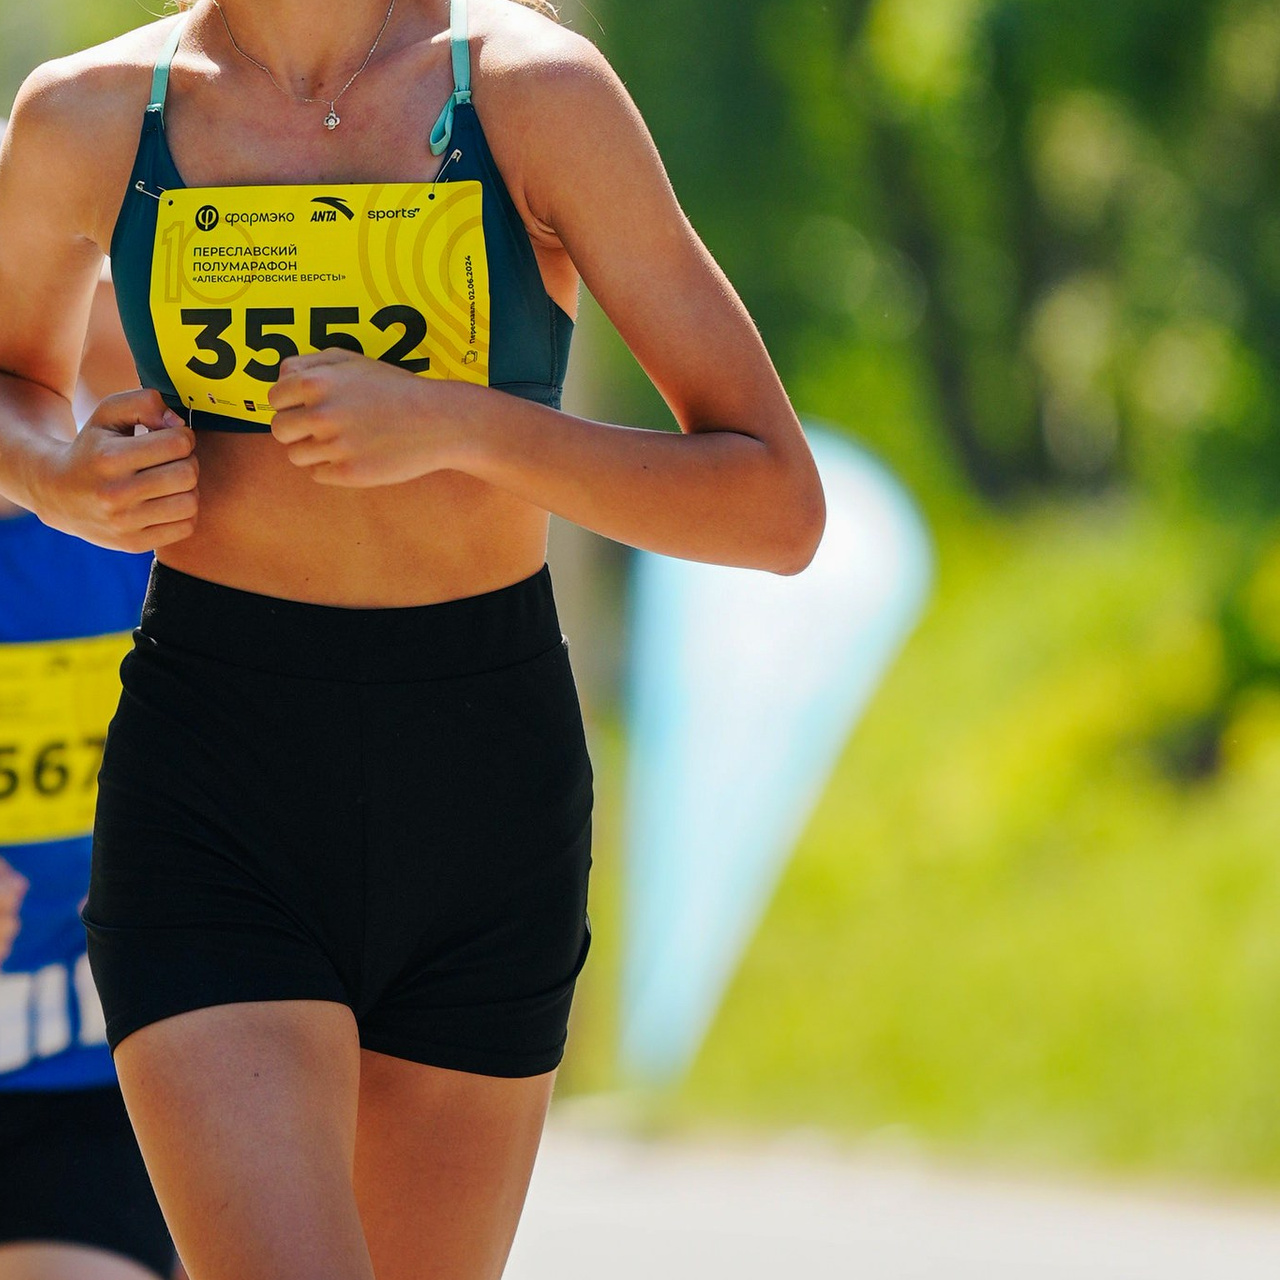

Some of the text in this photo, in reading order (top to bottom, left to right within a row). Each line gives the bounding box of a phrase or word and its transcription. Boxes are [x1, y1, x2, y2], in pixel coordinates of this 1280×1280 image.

[224, 211, 295, 226] фармэко
[310, 210, 337, 223] ANTA
[193, 244, 297, 257] ПЕРЕСЛАВСКИЙ
[193, 261, 297, 272] ПОЛУМАРАФОН
[192, 273, 346, 283] «АЛЕКСАНДРОВСКИЕ ВЕРСТЫ»
[465, 255, 476, 300] 02.06.2024
[180, 304, 430, 383] 3552
